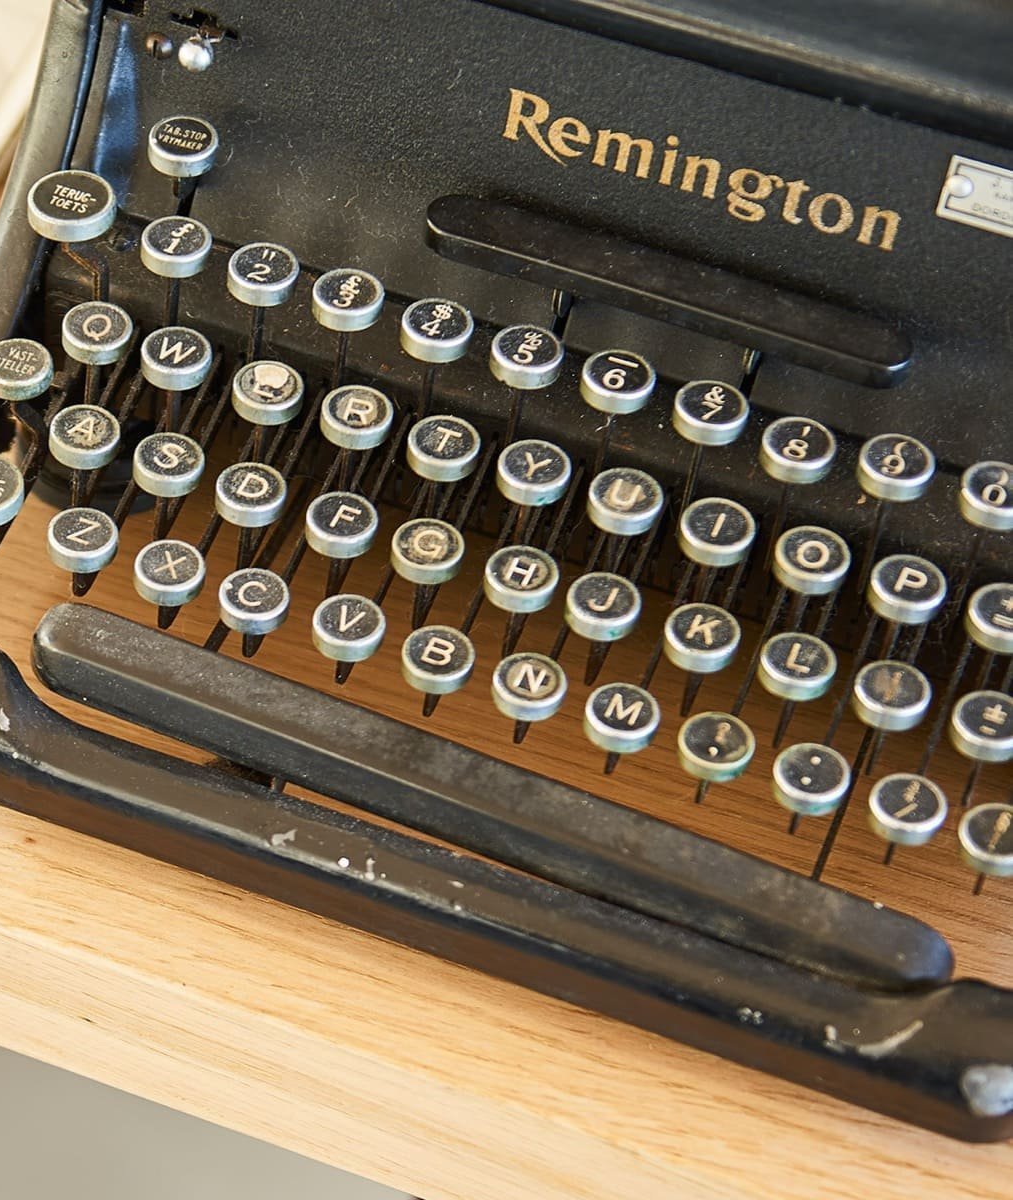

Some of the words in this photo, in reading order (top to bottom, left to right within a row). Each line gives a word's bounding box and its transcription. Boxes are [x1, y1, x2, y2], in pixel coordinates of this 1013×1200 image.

[503, 88, 901, 251] Remington
[49, 195, 89, 214] TOETS
[53, 184, 97, 203] TERUG-
[246, 263, 271, 281] 2
[82, 313, 112, 341] Q
[420, 318, 441, 337] 4
[159, 336, 197, 364] W
[513, 344, 534, 364] 5
[602, 368, 627, 390] 6
[342, 398, 374, 426] R
[66, 417, 95, 441] A
[436, 425, 463, 452] T
[152, 443, 187, 469] S
[782, 438, 809, 460] 8
[524, 452, 553, 480] Y
[881, 454, 906, 475] 9
[236, 472, 270, 498] D
[609, 478, 642, 509] U
[329, 504, 363, 528] F
[710, 512, 726, 538] I
[65, 516, 103, 545] Z
[414, 529, 447, 558] G
[154, 550, 187, 580] X
[796, 540, 830, 569] O
[504, 557, 537, 587] H
[893, 567, 928, 593] P
[237, 580, 268, 607] C
[589, 587, 620, 612] J
[338, 604, 367, 633] V
[686, 614, 722, 645] K
[420, 636, 456, 666] B
[786, 642, 811, 674] L
[514, 663, 548, 694] N
[603, 692, 645, 727] M
